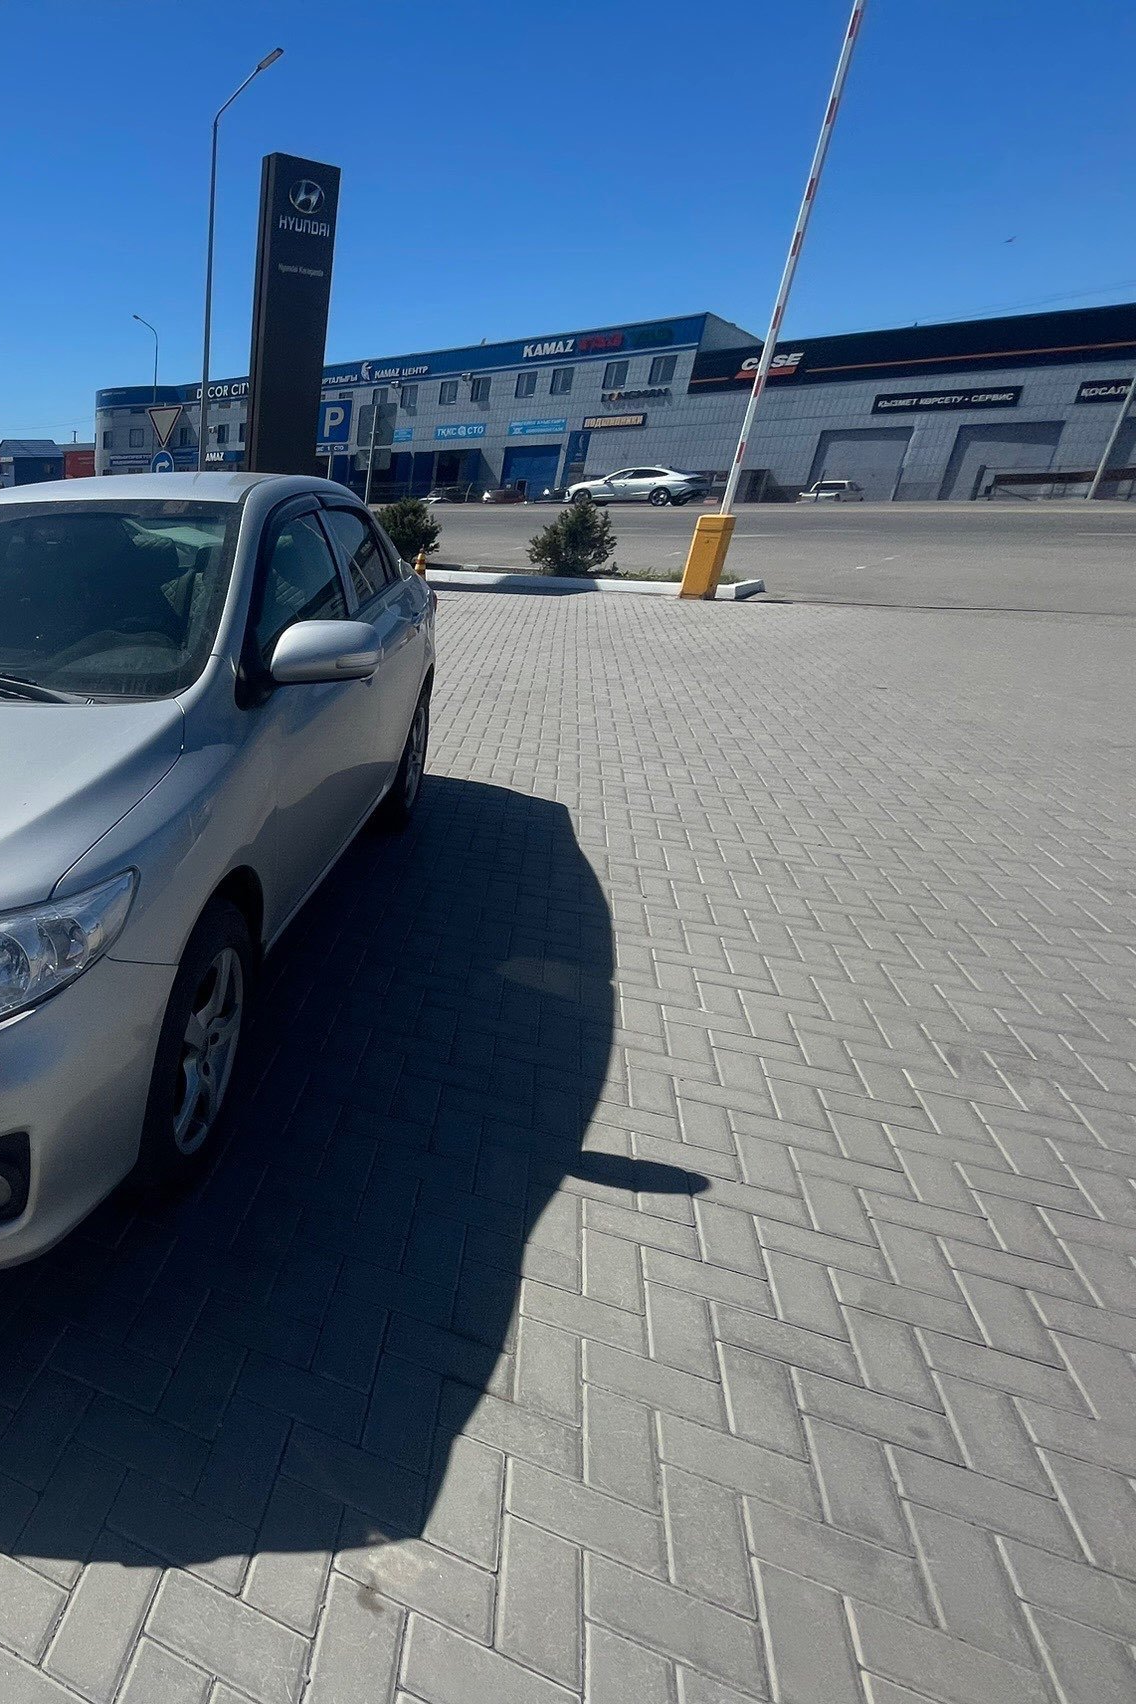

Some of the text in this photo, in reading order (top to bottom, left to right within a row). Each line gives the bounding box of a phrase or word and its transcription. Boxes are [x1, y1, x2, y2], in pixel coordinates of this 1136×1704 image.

[279, 214, 331, 237] HYUNDAI
[522, 338, 575, 358] KAMAZ
[741, 352, 805, 371] CSE
[322, 374, 358, 385] РТАЛЫҒЫ
[374, 365, 429, 379] KAMAZ ЦЕНТР
[196, 384, 229, 400] DCOR
[971, 392, 1015, 403] СЕРВИС
[466, 425, 484, 435] СТО
